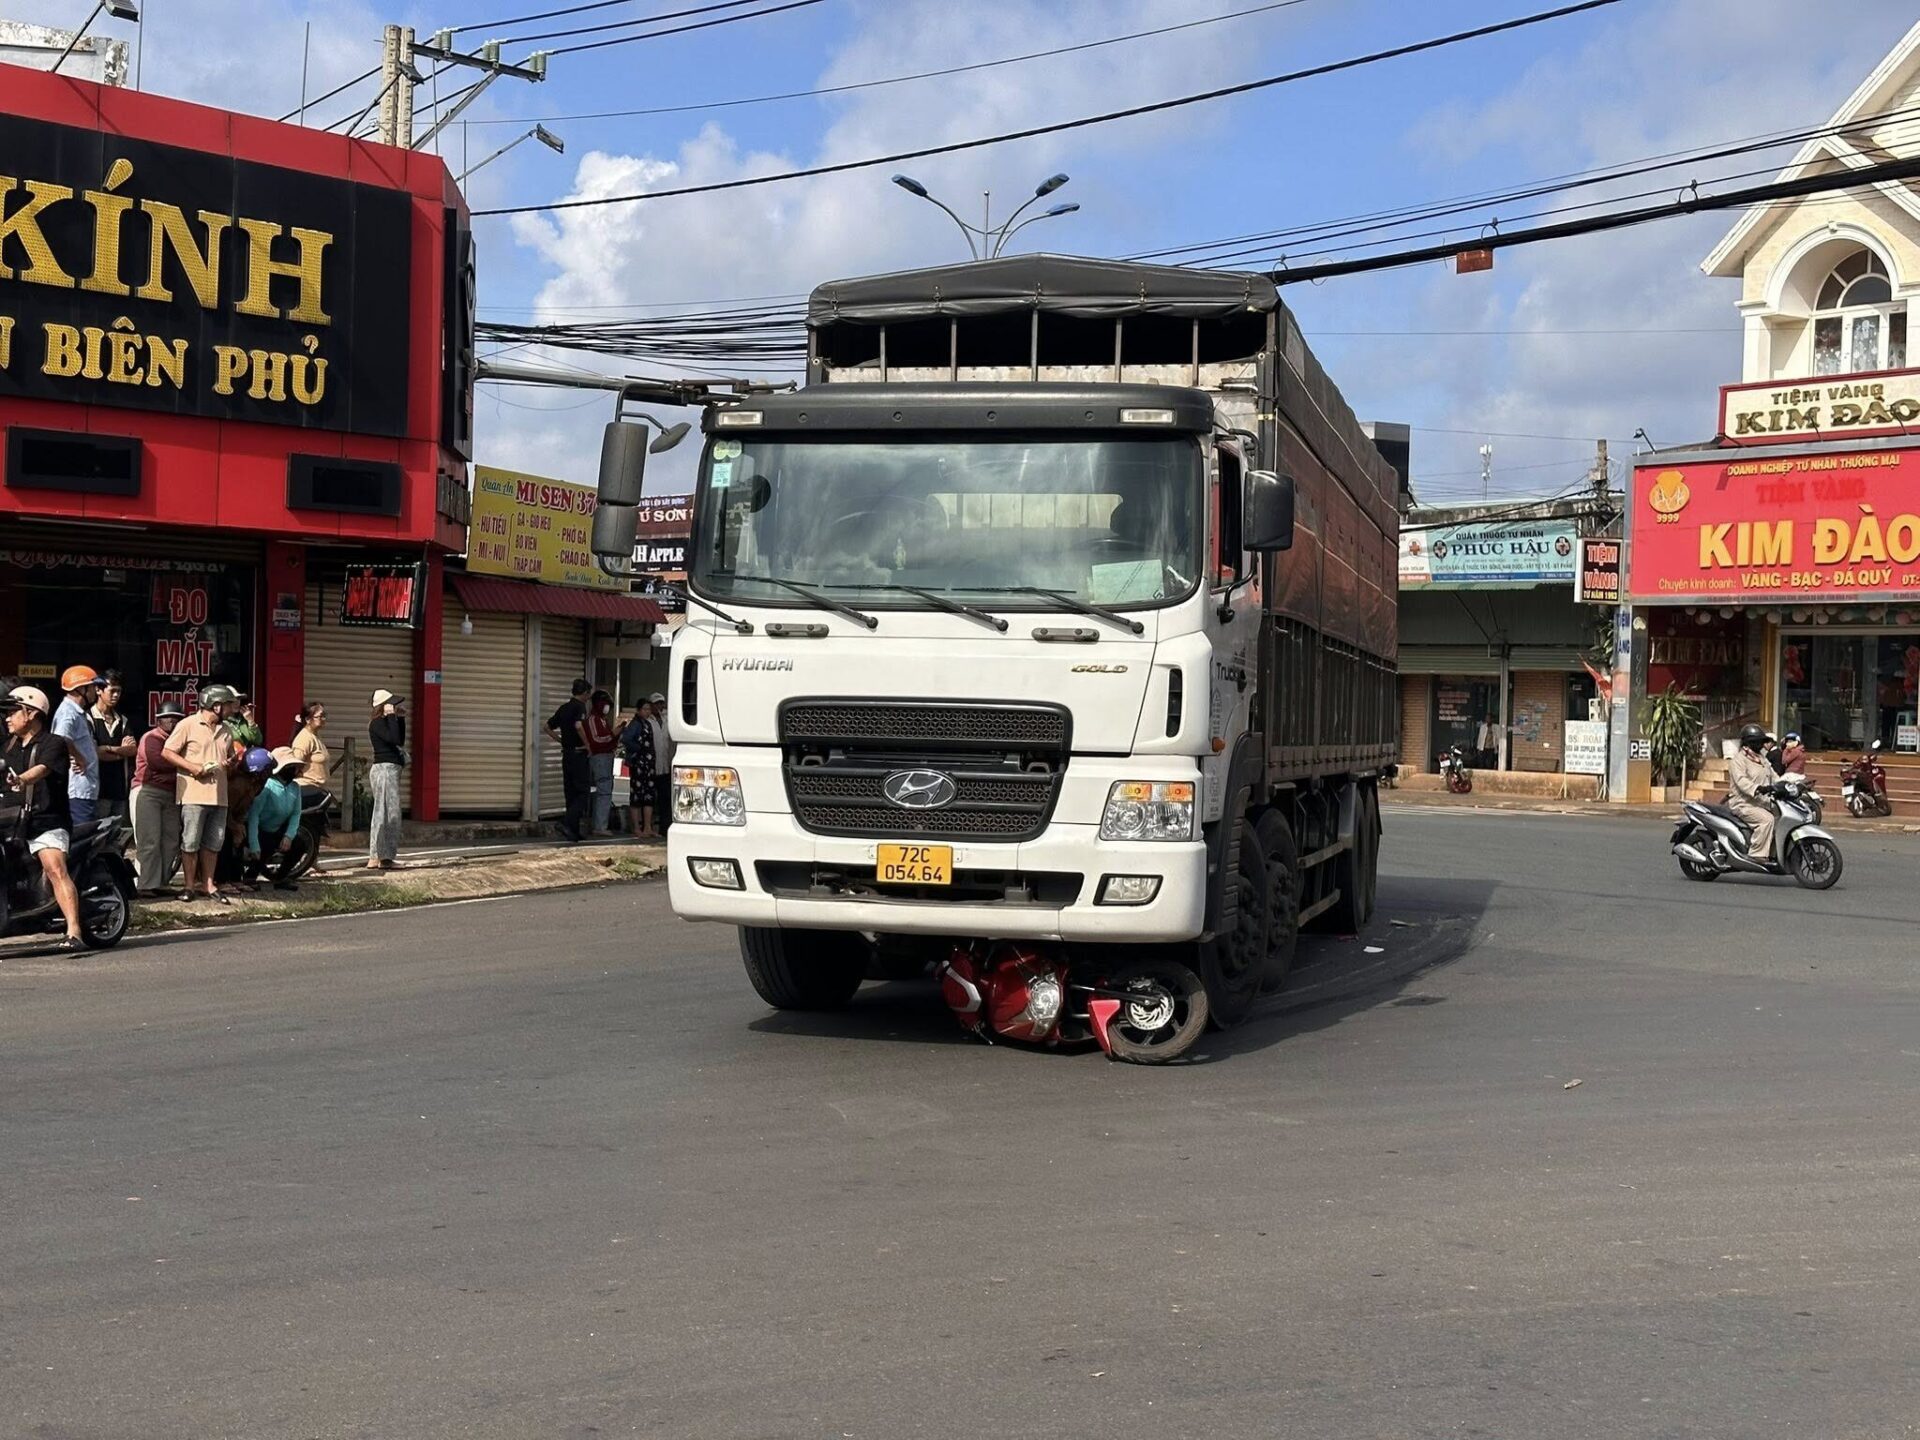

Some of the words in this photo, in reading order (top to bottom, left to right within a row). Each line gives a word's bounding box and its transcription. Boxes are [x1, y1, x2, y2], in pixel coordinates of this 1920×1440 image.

[0, 158, 333, 326] KÍNH
[42, 316, 189, 390] BIÊN
[213, 334, 328, 405] PHỦ
[1771, 388, 1820, 406] TIỆM
[1828, 383, 1884, 400] VÀNG
[1735, 406, 1820, 435] KIM
[1830, 396, 1920, 427] ĐÀO
[1727, 464, 1758, 476] DOANH
[1760, 460, 1793, 476] NGHIỆP
[1795, 460, 1810, 471] TƯ
[1810, 458, 1837, 470] NHÂN
[1881, 455, 1900, 470] MẠI
[540, 485, 576, 512] SEN
[653, 508, 688, 522] SƠN
[1656, 512, 1680, 525] 9999
[1520, 530, 1544, 538] NHÂN
[1700, 519, 1794, 568] KIM
[1812, 503, 1920, 564] ĐÀO
[648, 547, 684, 562] APPLE
[1451, 539, 1504, 556] PHÚC
[1510, 539, 1550, 557] HẬU
[1587, 542, 1617, 566] TIỆM
[1584, 568, 1618, 589] VÀNG
[1741, 568, 1781, 589] VÀNG
[1791, 571, 1822, 592] BẠC
[1833, 567, 1855, 587] ĐÁ
[1857, 566, 1893, 586] QUÝ
[169, 588, 208, 625] ĐO
[156, 627, 214, 676] MẮT
[722, 658, 793, 671] HYUNDAI
[1071, 665, 1128, 673] GOLD
[899, 847, 930, 863] 72C
[885, 864, 943, 882] 054.64
